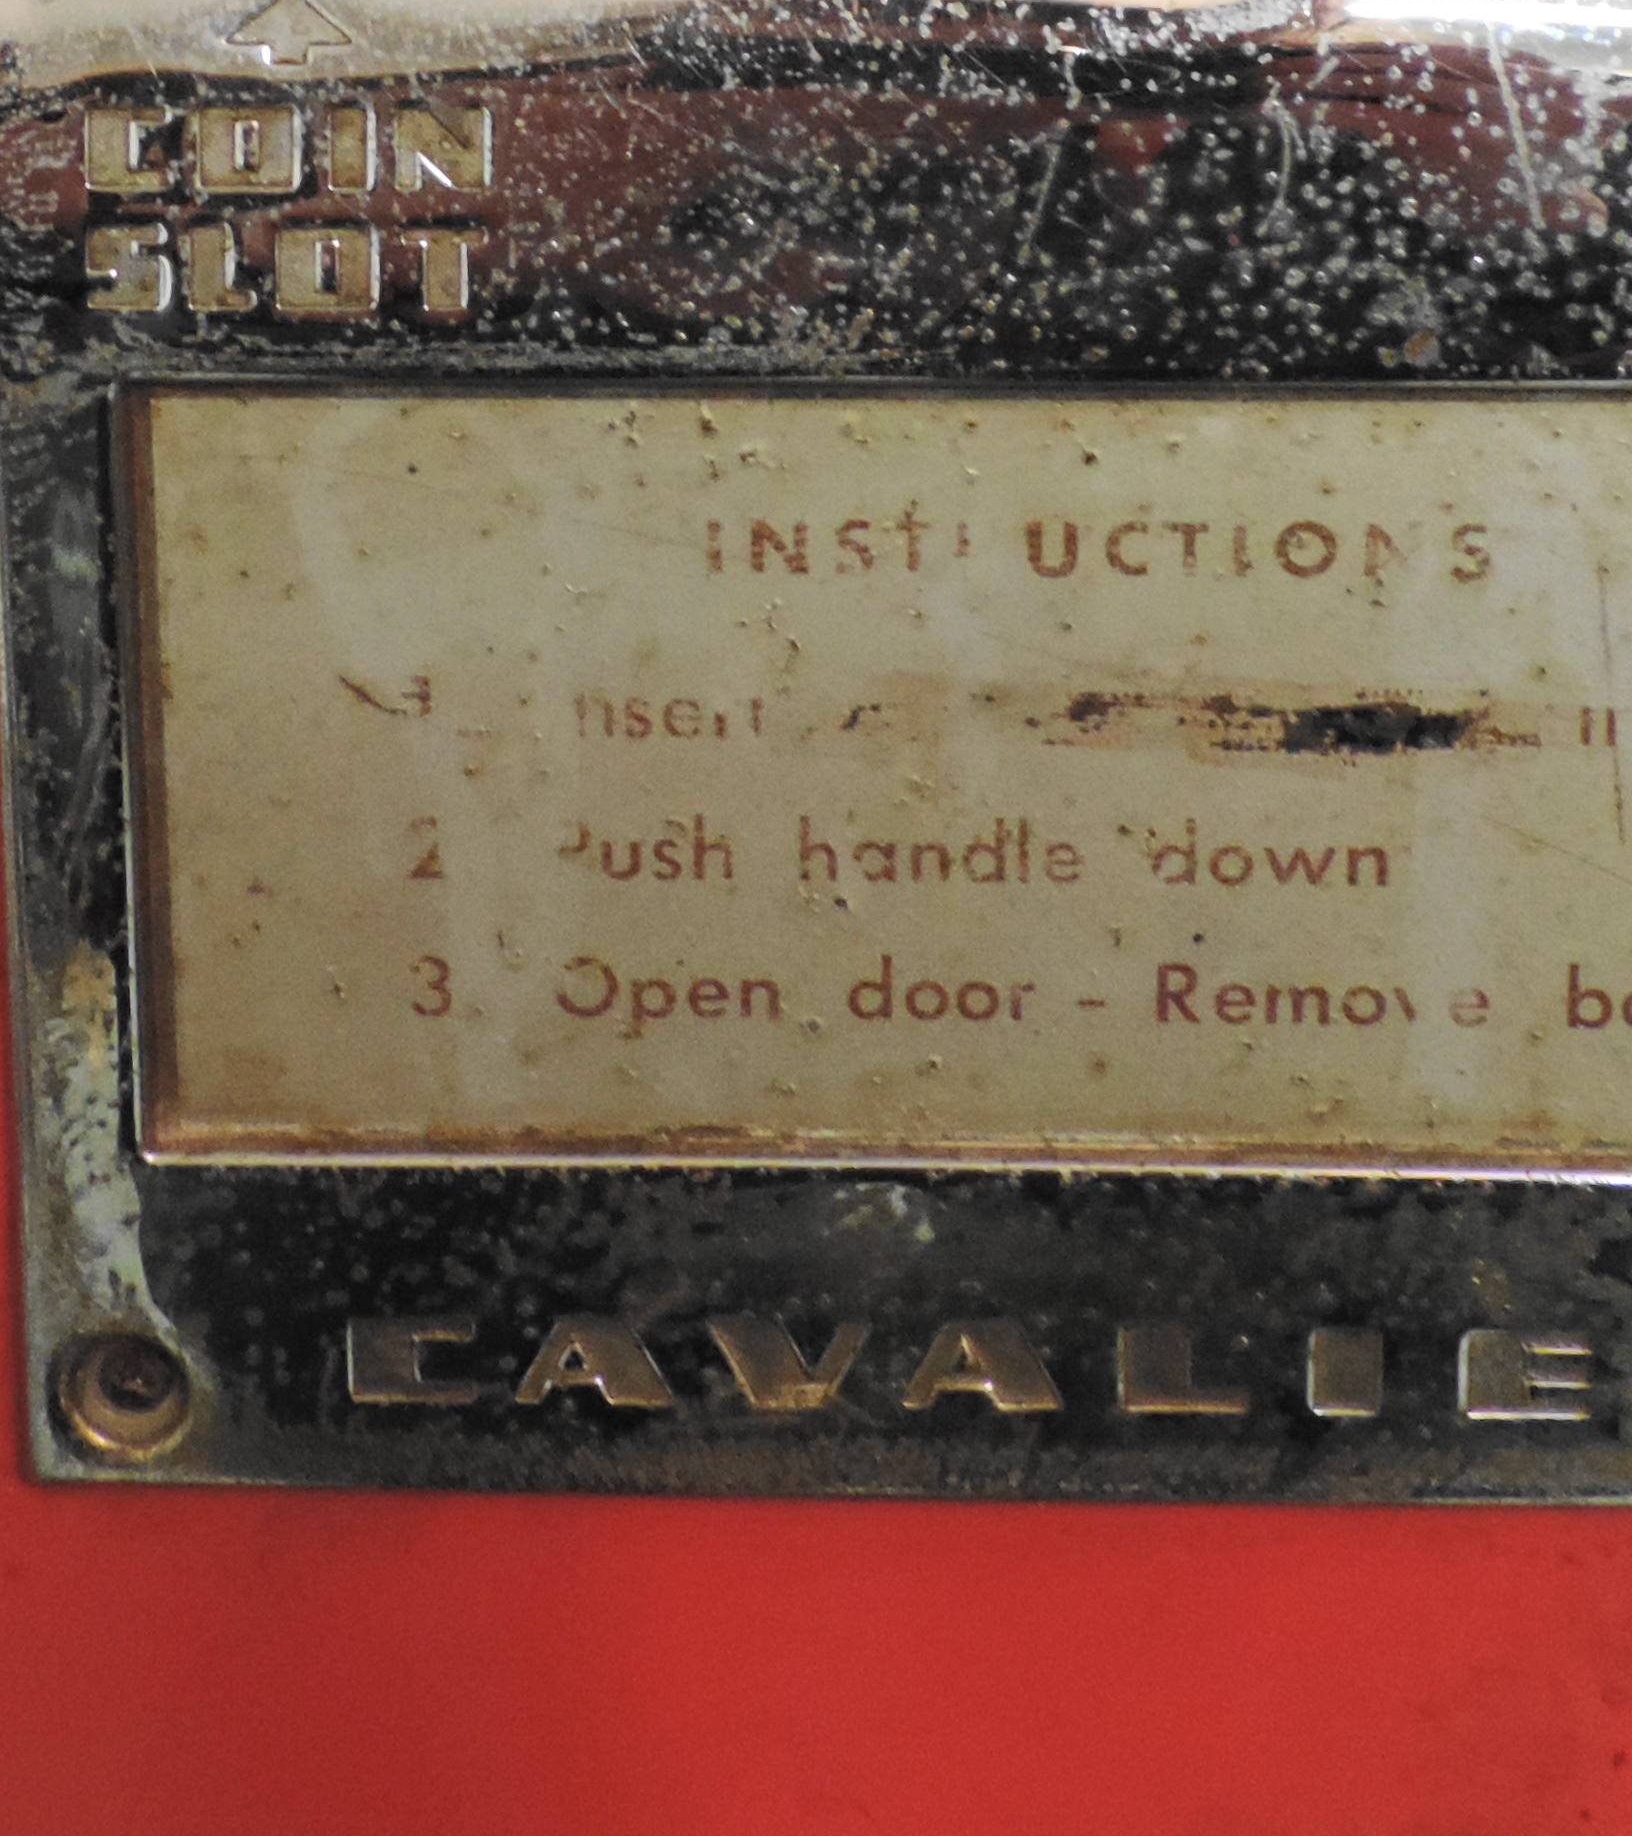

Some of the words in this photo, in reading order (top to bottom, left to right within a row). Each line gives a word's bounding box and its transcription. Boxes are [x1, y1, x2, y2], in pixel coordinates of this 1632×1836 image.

[83, 102, 492, 196] COIN
[83, 219, 490, 313] SLOT
[705, 504, 1493, 580] INSTUCTIONS
[798, 812, 1086, 886] handle
[1150, 818, 1391, 888] down
[556, 956, 782, 1038] Open
[846, 954, 1036, 1024] door
